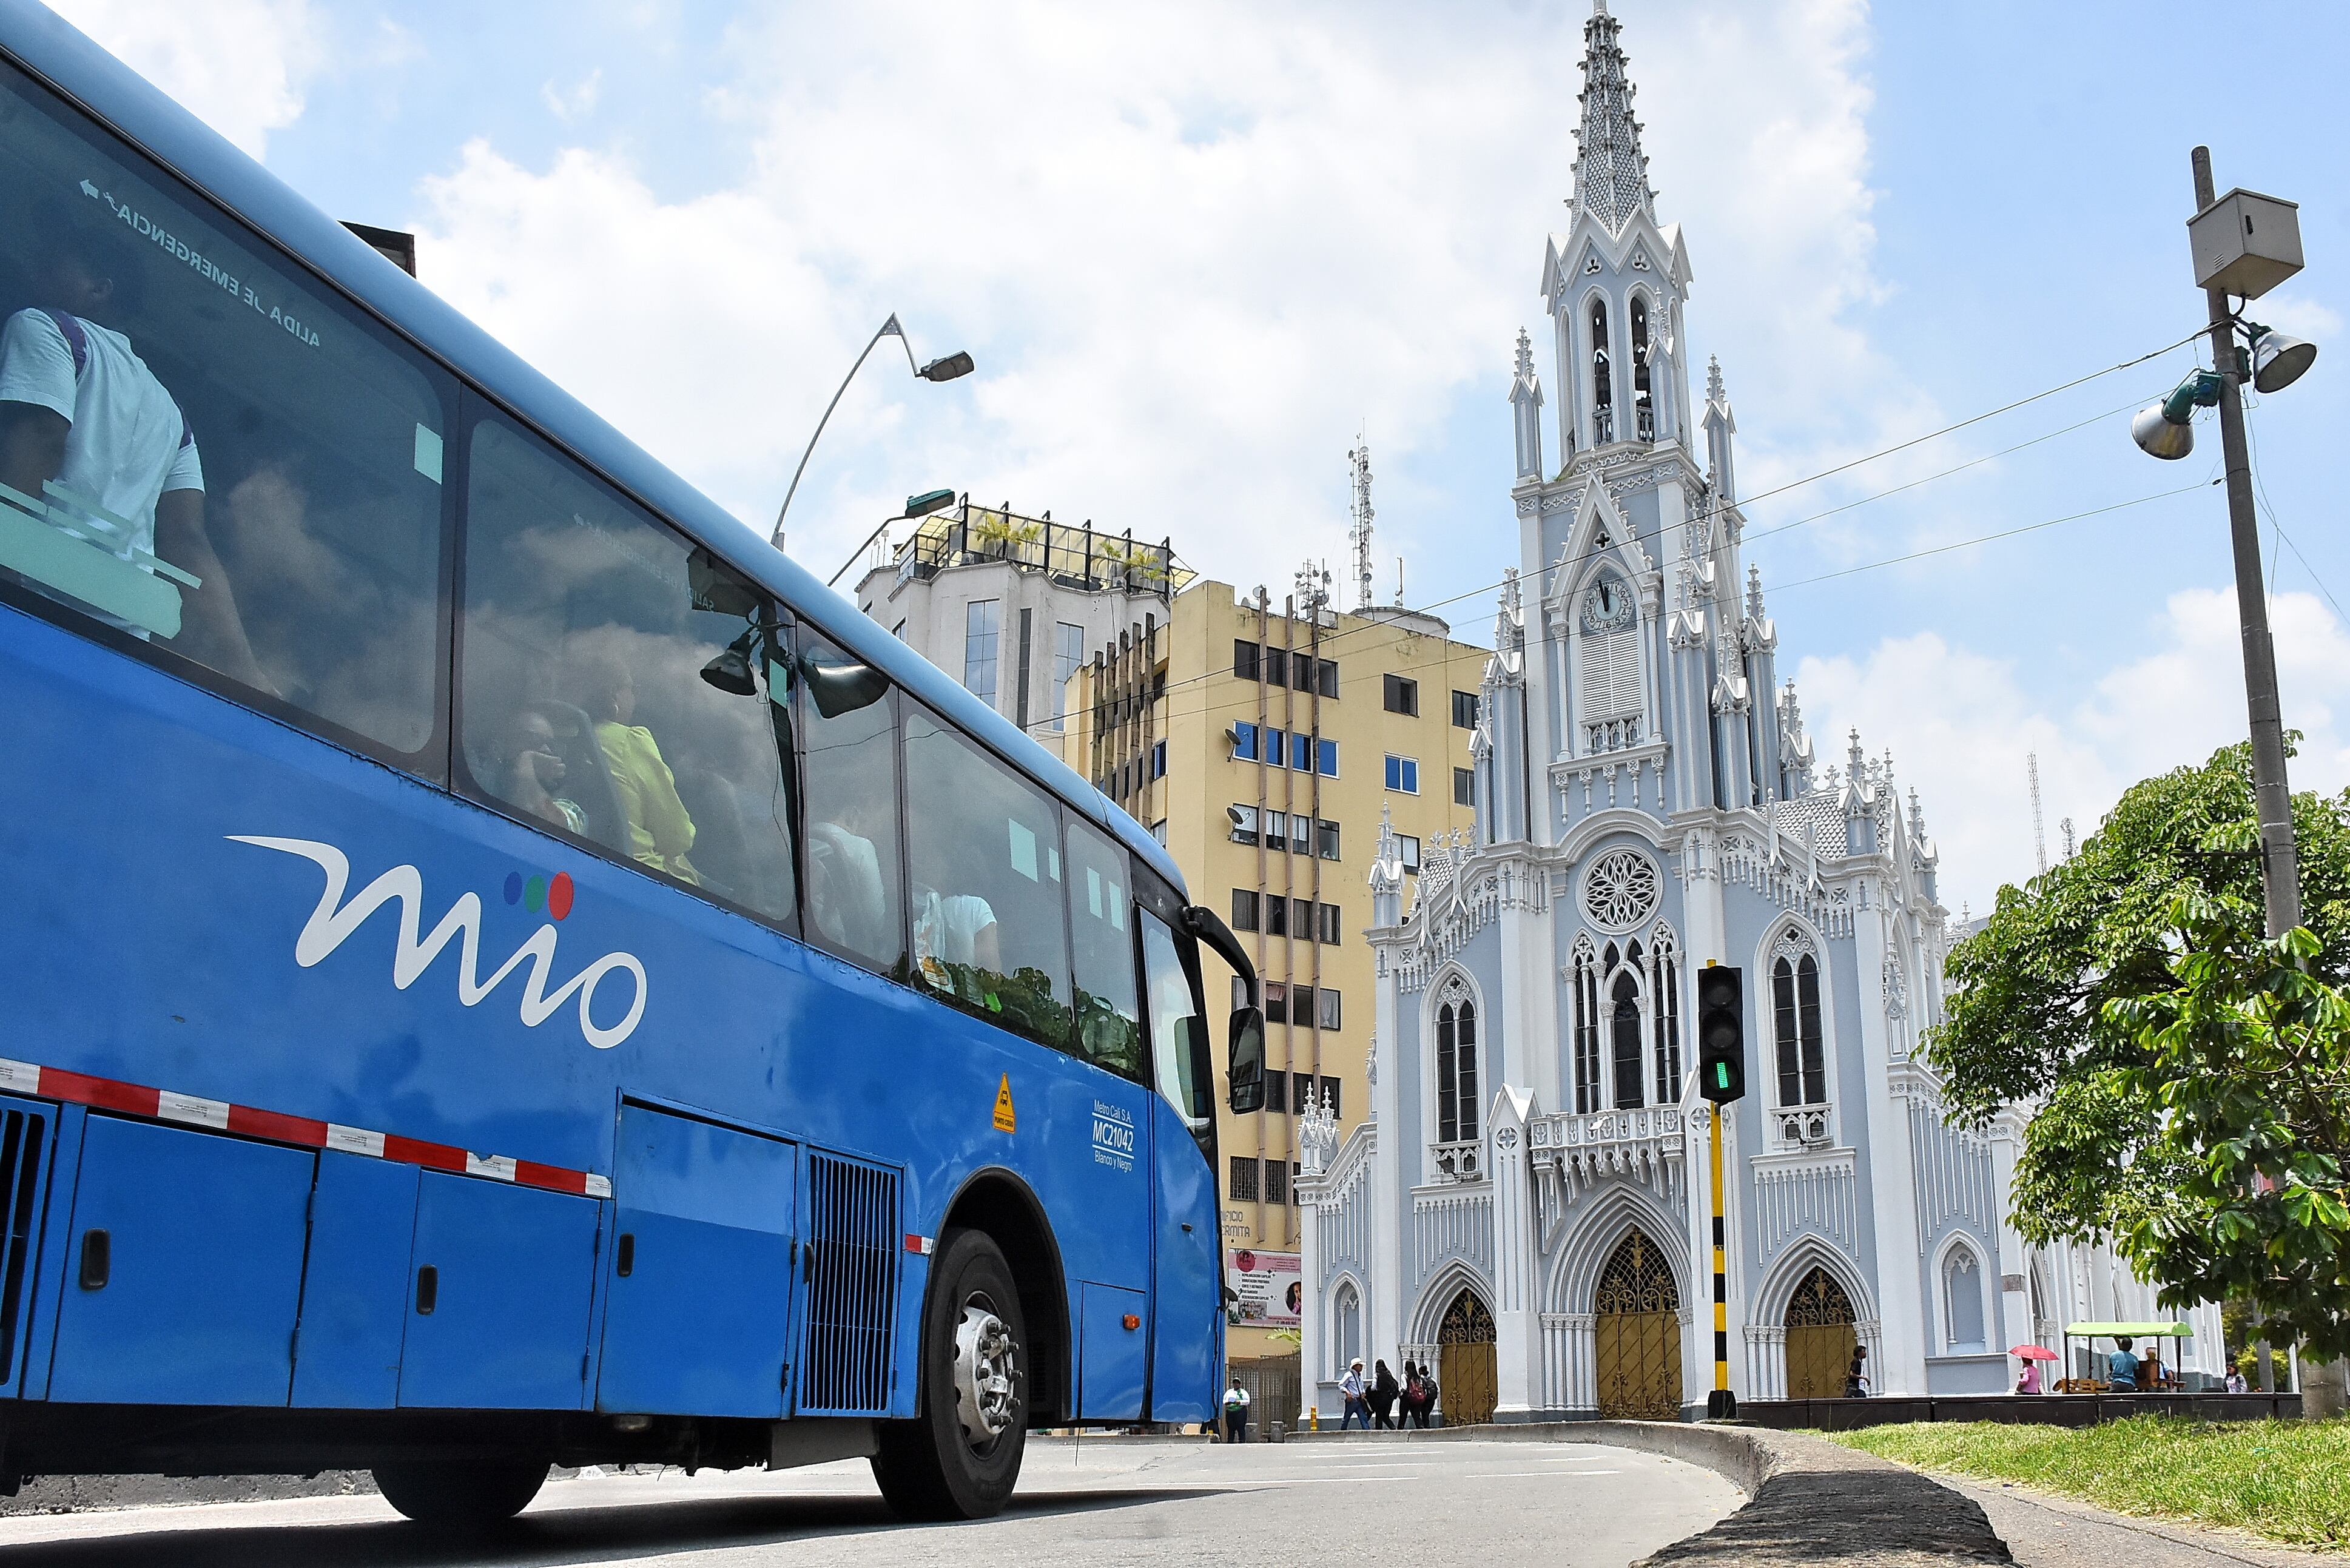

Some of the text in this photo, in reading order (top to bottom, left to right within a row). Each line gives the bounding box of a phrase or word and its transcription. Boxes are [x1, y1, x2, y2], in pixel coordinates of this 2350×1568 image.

[1094, 1099, 1109, 1115] Metro
[1110, 1105, 1120, 1120] Cali
[1093, 1120, 1134, 1152] MC21042
[1094, 1149, 1132, 1173] Blanco y Negro
